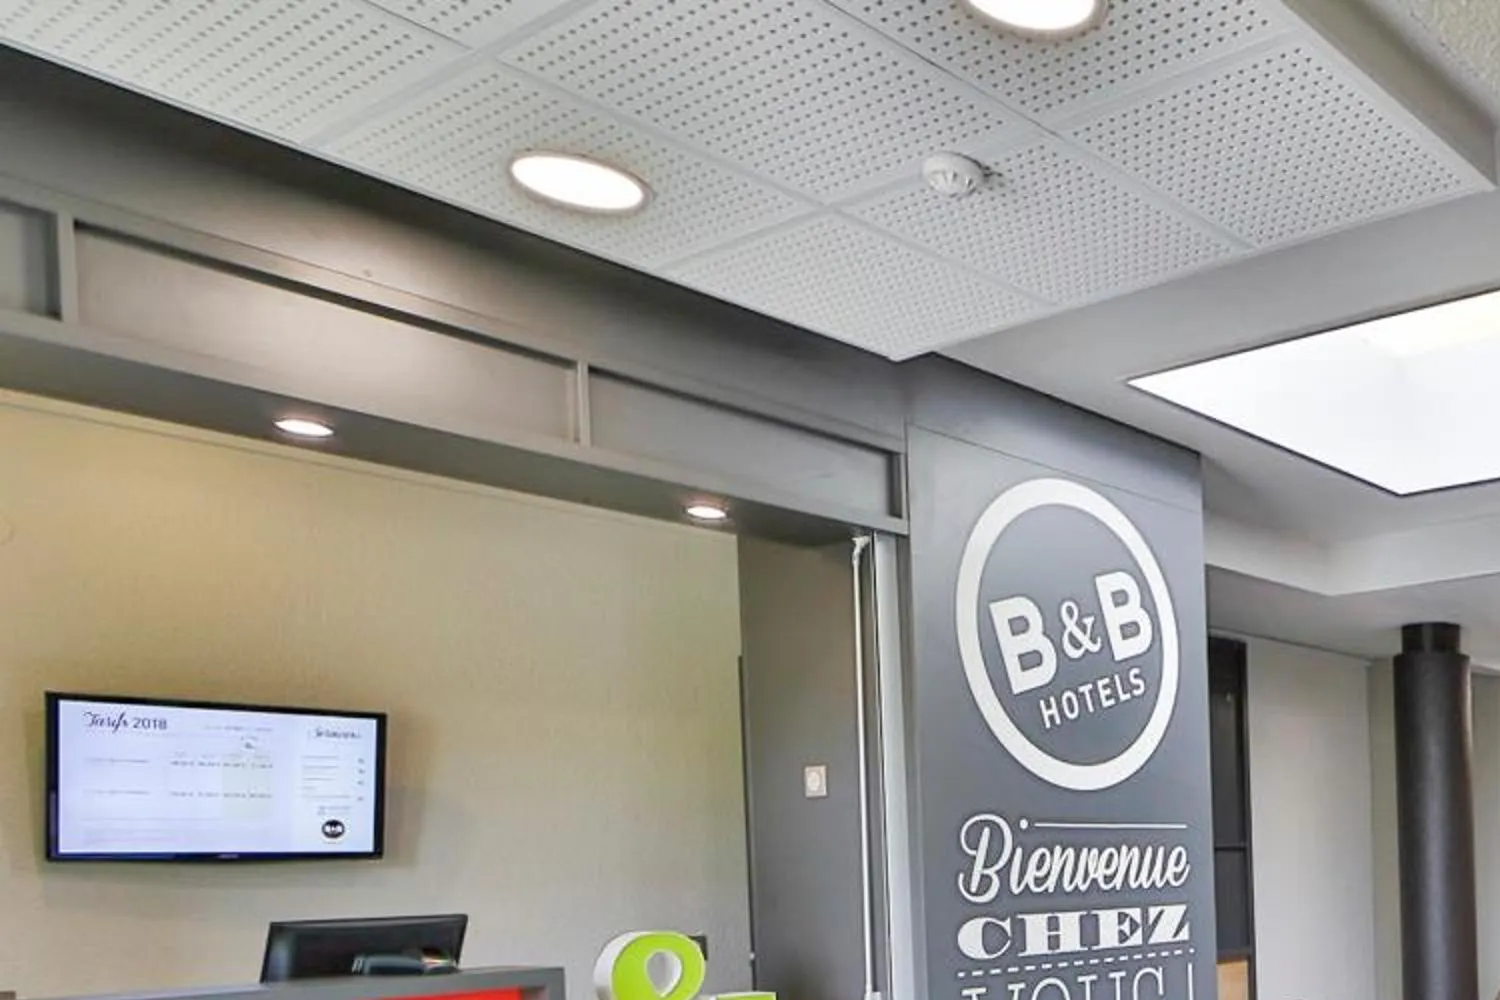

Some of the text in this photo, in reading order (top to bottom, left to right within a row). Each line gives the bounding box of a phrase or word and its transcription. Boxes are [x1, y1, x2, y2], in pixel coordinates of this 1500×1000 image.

[988, 571, 1153, 695] B&B
[132, 717, 168, 730] 2018
[1039, 667, 1146, 729] HOTELS
[958, 813, 1191, 903] Bienvenue
[957, 903, 1190, 960] CHEZ
